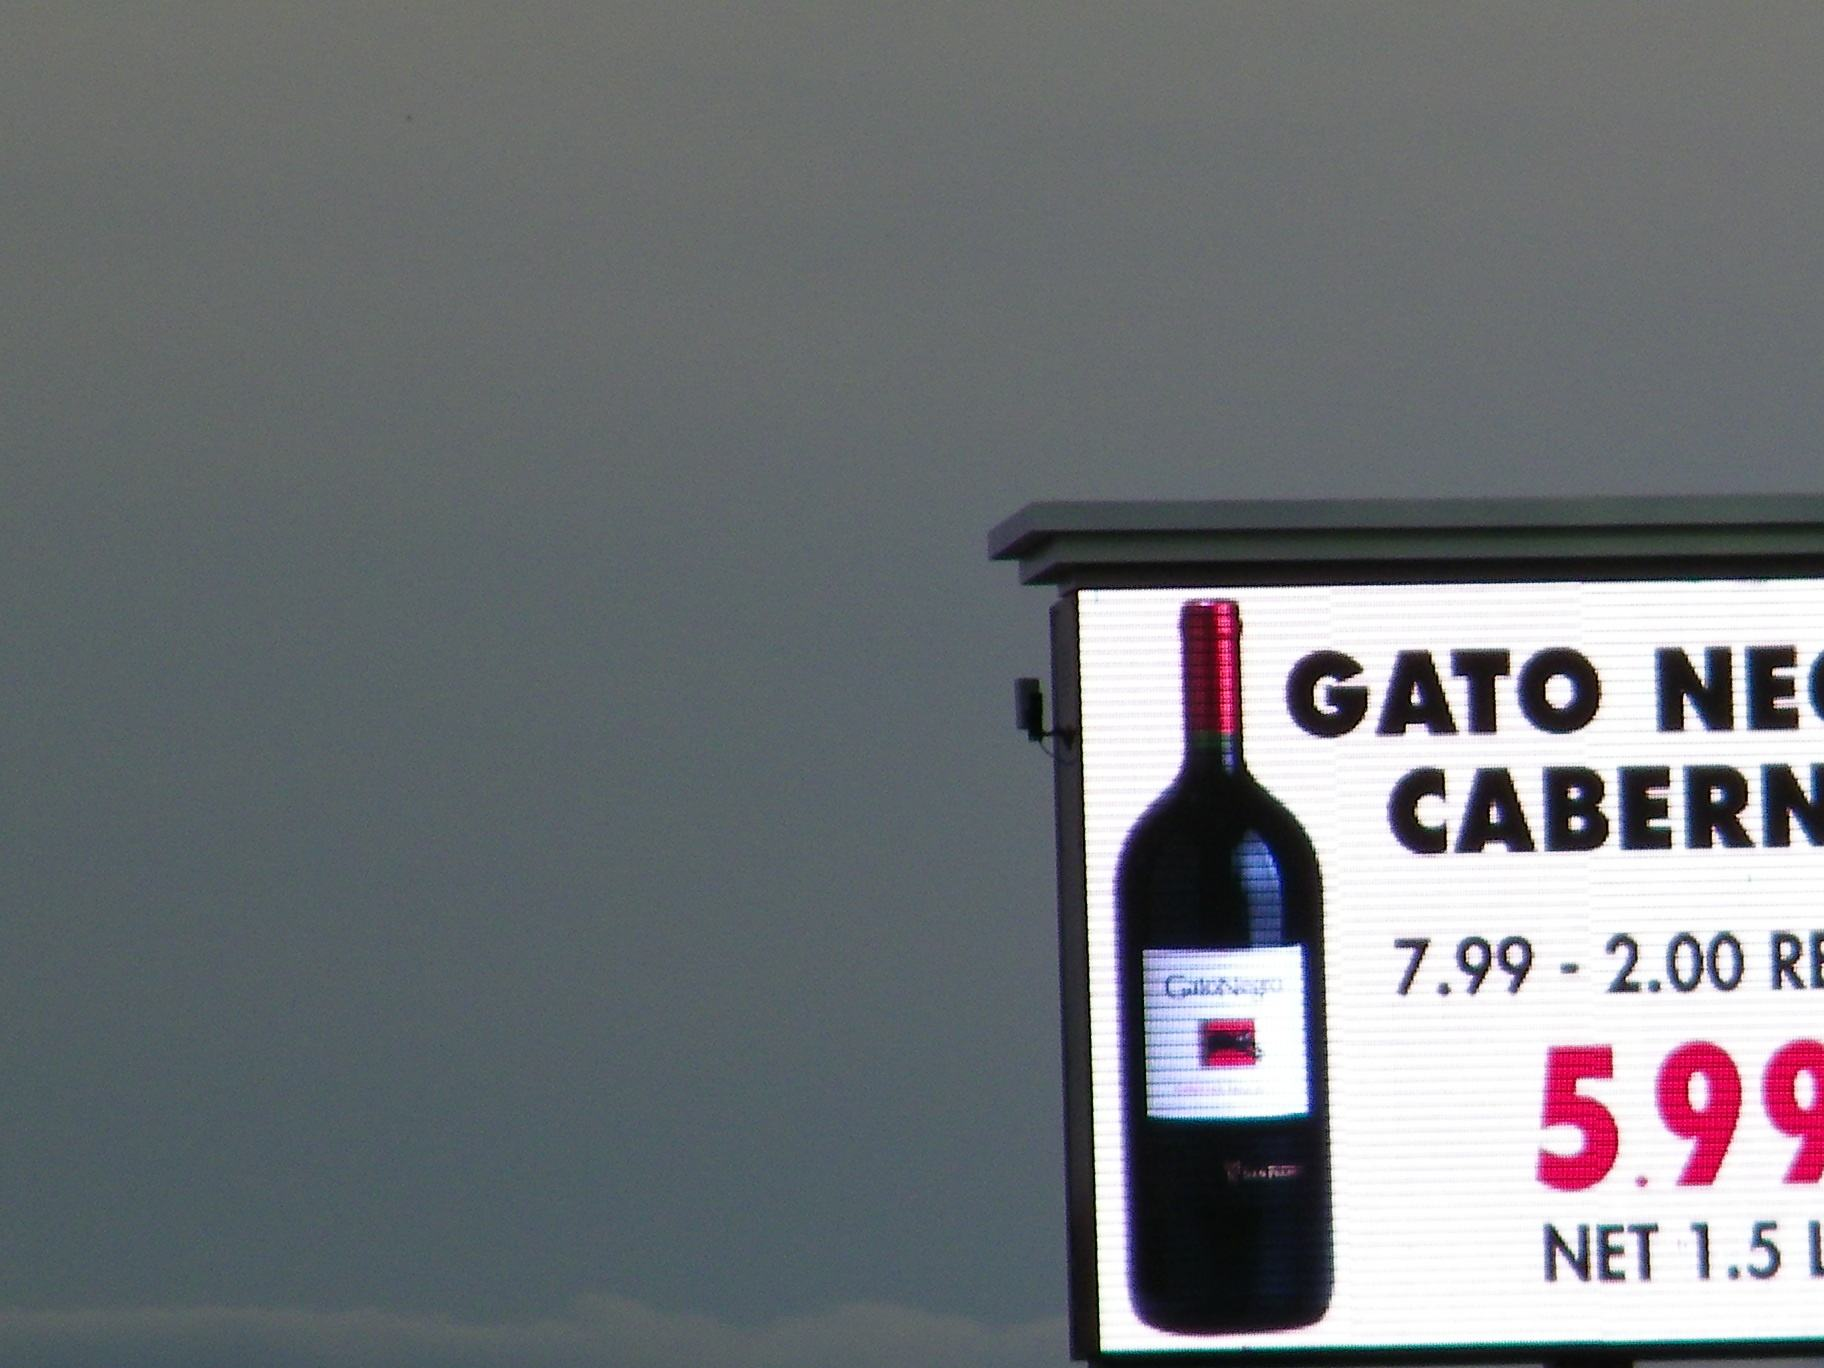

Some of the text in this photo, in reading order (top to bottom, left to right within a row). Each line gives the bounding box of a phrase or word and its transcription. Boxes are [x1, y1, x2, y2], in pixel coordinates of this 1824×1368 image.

[1284, 646, 1604, 740] GATO
[1394, 935, 1535, 997] 7.99
[1606, 930, 1746, 994] 2.00
[1543, 1222, 1660, 1283] NET
[1691, 1220, 1782, 1281] 1.5
